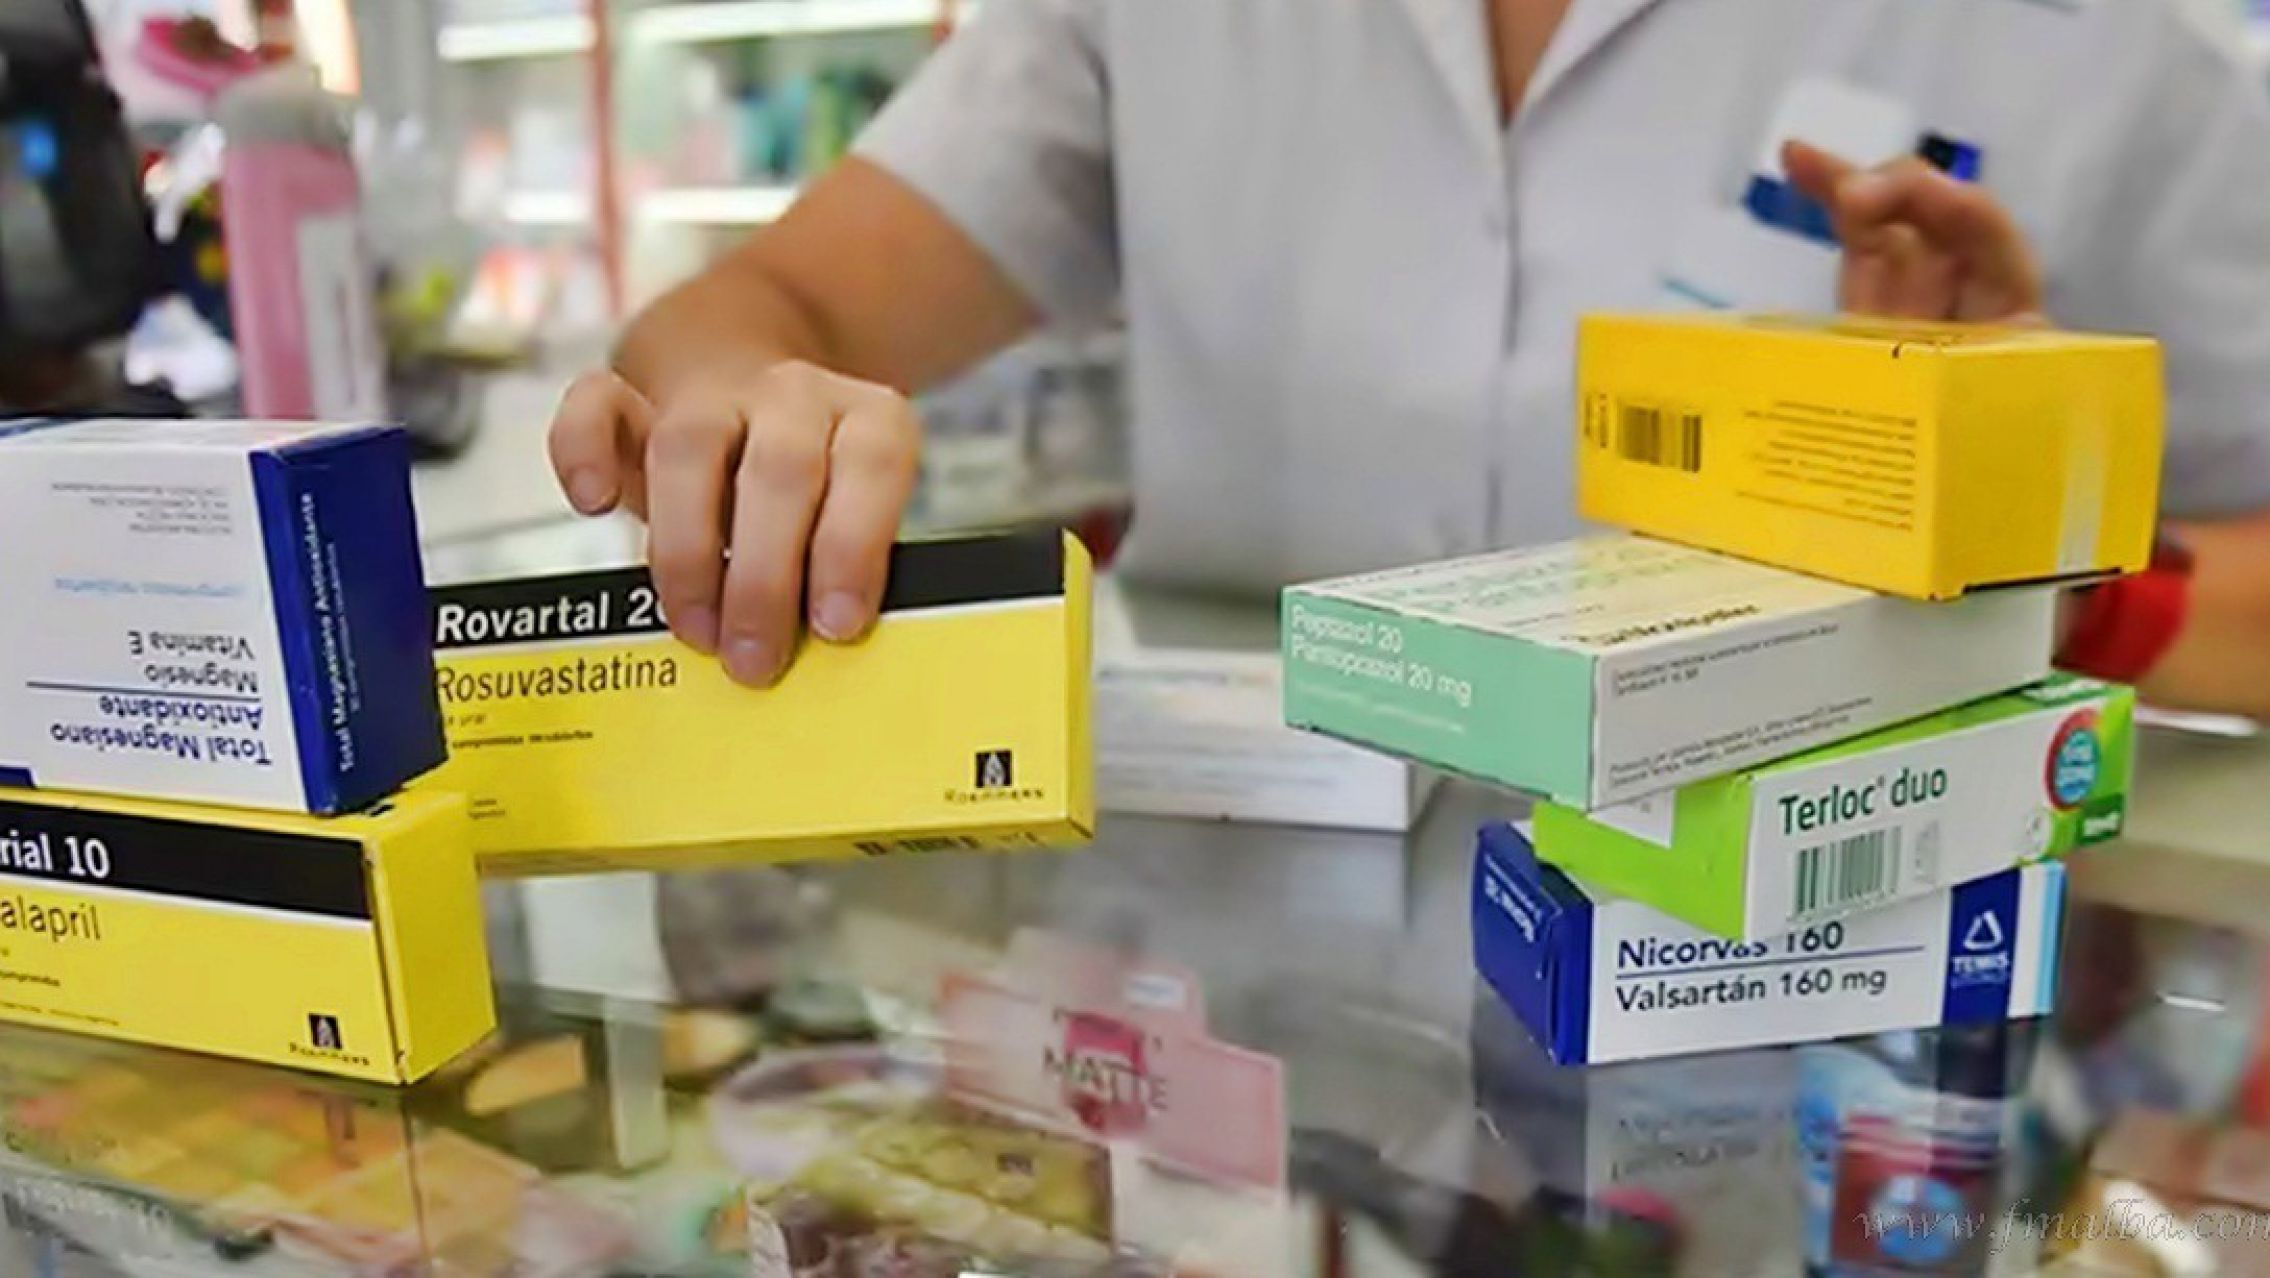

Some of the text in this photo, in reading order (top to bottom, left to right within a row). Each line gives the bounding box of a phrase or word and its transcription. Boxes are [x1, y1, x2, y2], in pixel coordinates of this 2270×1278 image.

[436, 591, 610, 643] Rovartal
[1377, 613, 1403, 655] 20
[127, 629, 256, 661] Vitamina E
[144, 661, 258, 693] Magnesio
[434, 651, 678, 704] Rosuvastatina
[1407, 662, 1433, 692] 20
[1436, 675, 1473, 709] mg
[99, 694, 263, 731] Antioxidante
[50, 722, 273, 766] Total Magnesiano
[336, 726, 355, 772] Total
[1889, 766, 1948, 808] duo
[63, 835, 111, 879] 10
[0, 895, 102, 943] alapril
[1617, 920, 1844, 970] Nicorvas 160
[1615, 968, 1888, 1013] Valsartán 160 mg
[1043, 1046, 1169, 1112] MATTE
